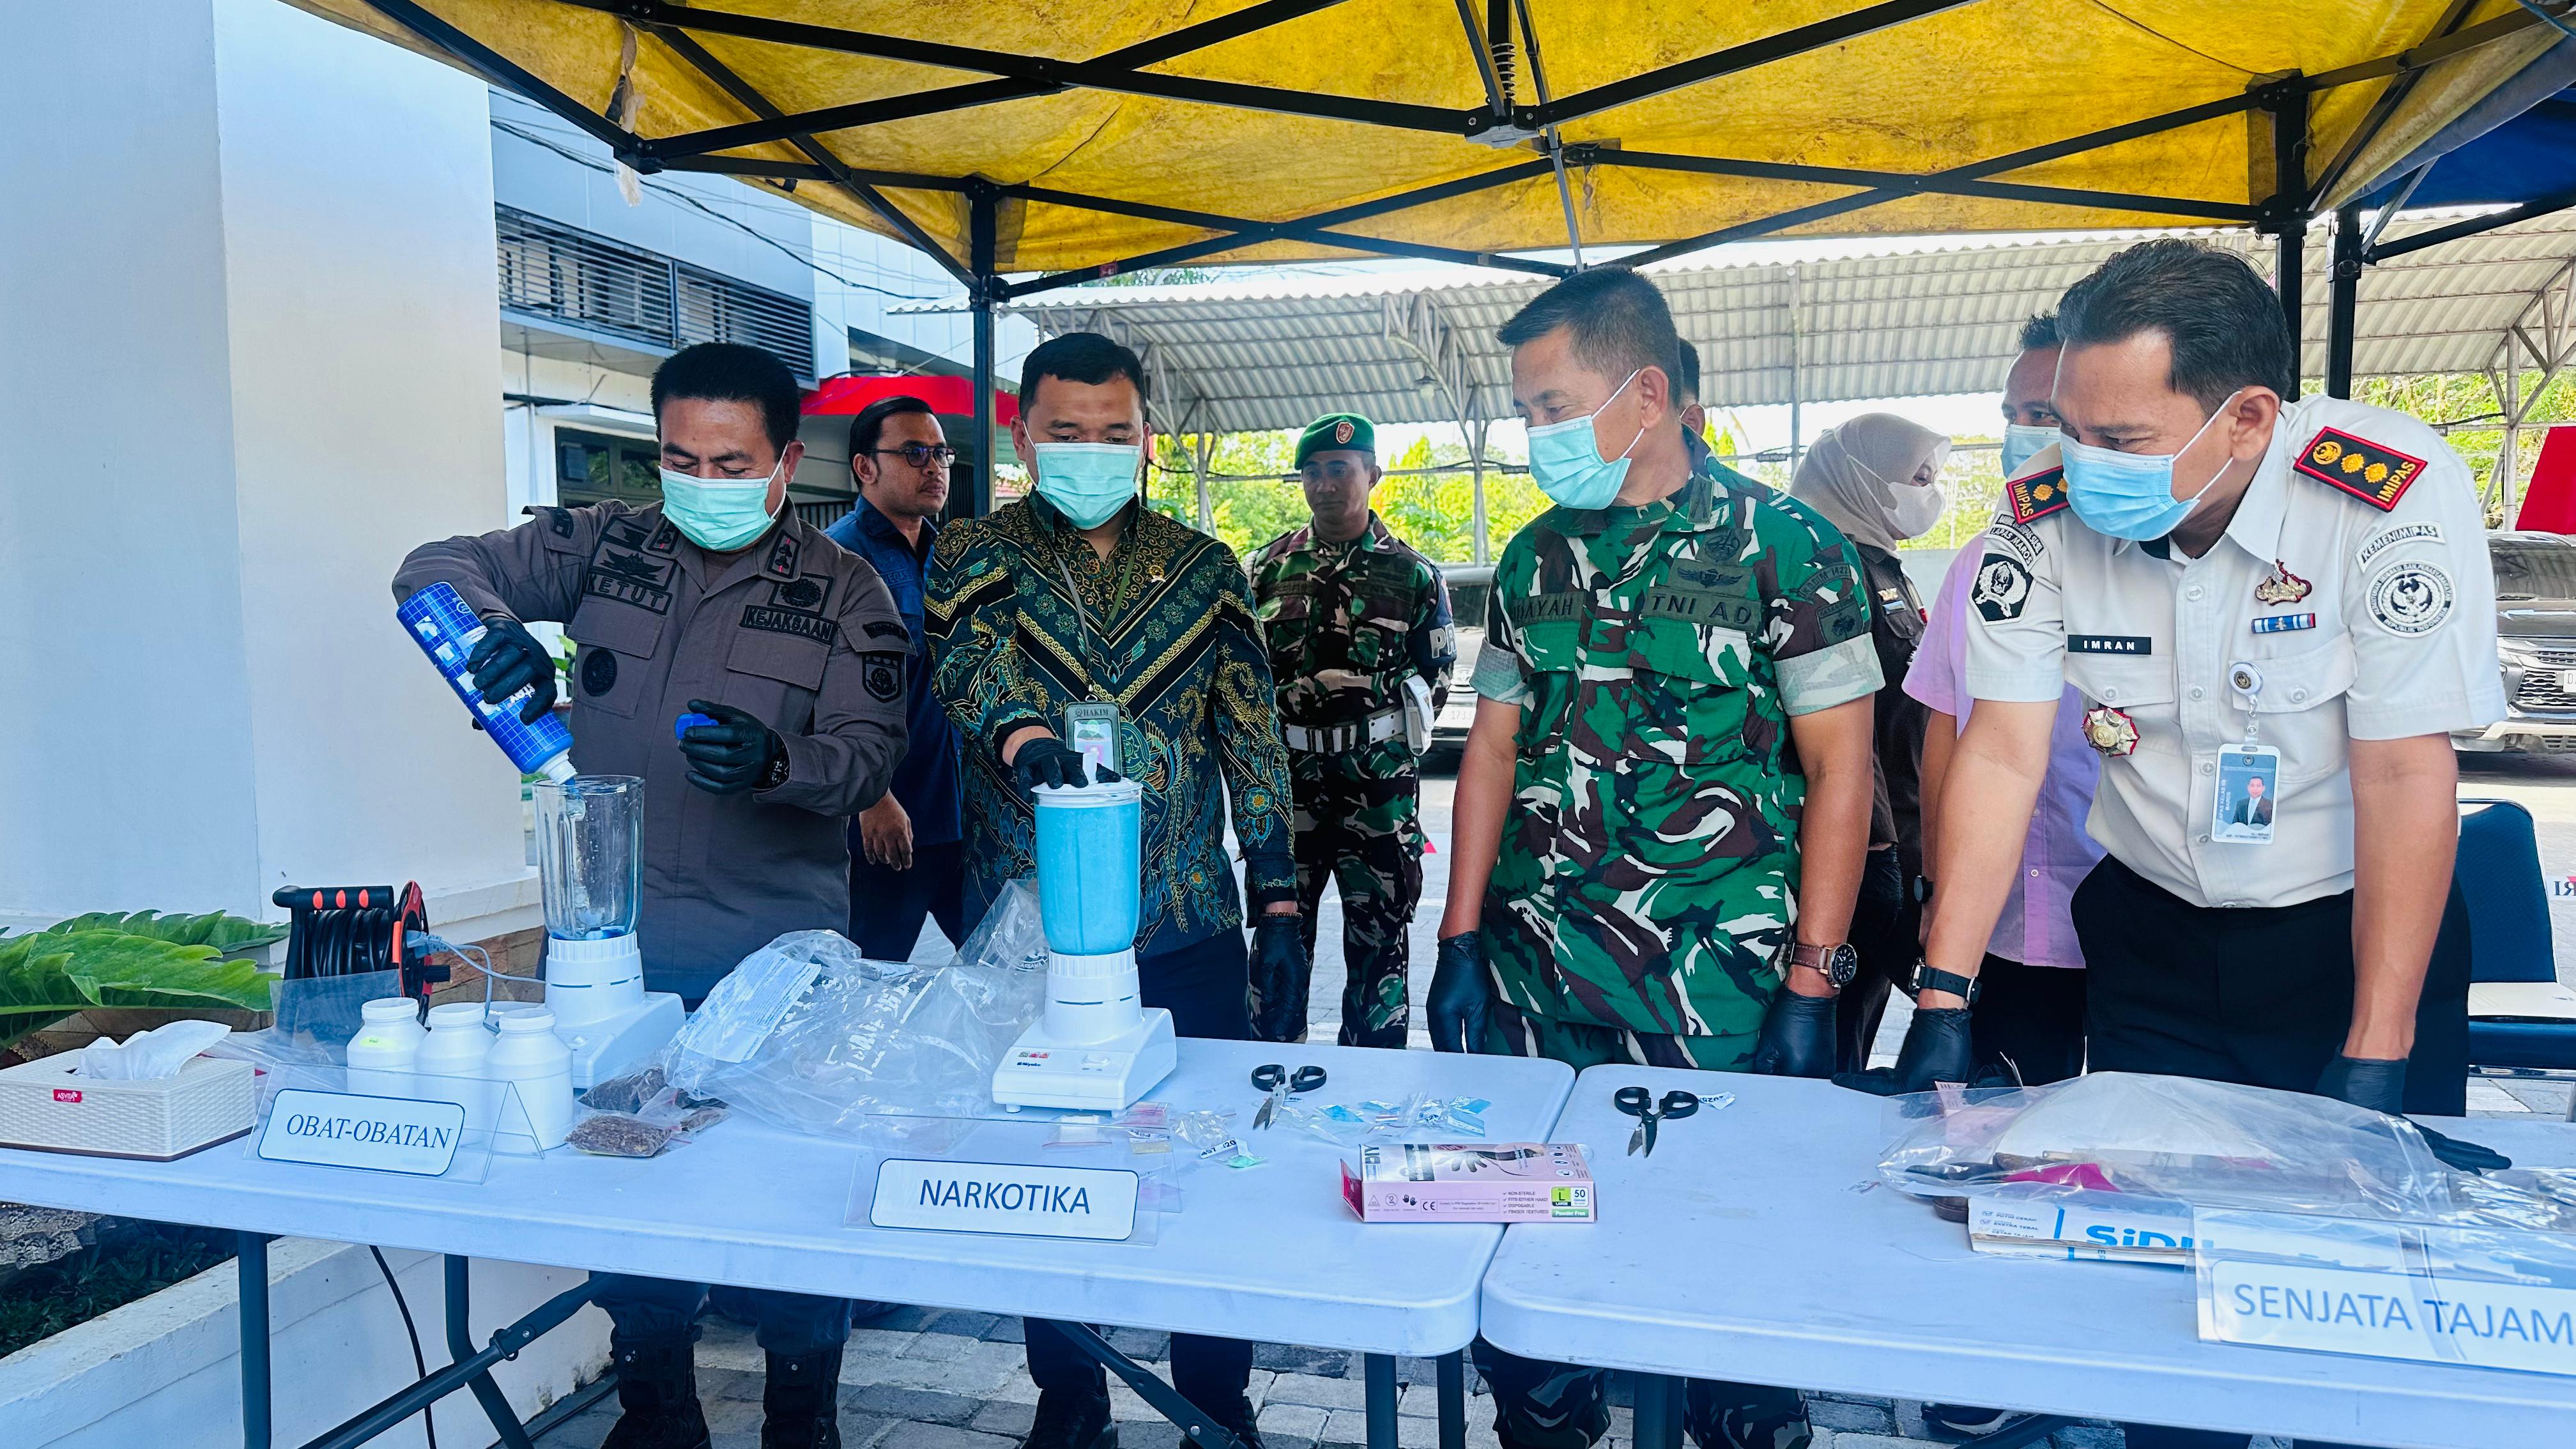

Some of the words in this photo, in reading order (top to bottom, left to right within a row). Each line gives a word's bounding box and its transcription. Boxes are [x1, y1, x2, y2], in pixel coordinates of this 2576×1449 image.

[2377, 461, 2416, 502] IMIPAS
[2013, 482, 2034, 517] IMIPAS
[1990, 527, 2013, 539] LAPAS
[2012, 537, 2033, 565] MAROS
[2362, 526, 2437, 561] KEMENIMIPAS
[588, 574, 664, 608] KETUT
[746, 608, 833, 640] KEJAKSAAN
[1652, 592, 1697, 615] TNI
[1708, 601, 1752, 625] AD
[2083, 640, 2135, 651] IMRAN
[1083, 708, 1109, 716] HAKIM
[286, 1114, 452, 1149] OBAT-OBATAN
[919, 1179, 1091, 1215] NARKOTIKA
[1558, 1192, 1565, 1201] L
[1574, 1189, 1586, 1198] 50
[2235, 1284, 2413, 1331] SENJATA
[2423, 1299, 2574, 1346] TAJAM
